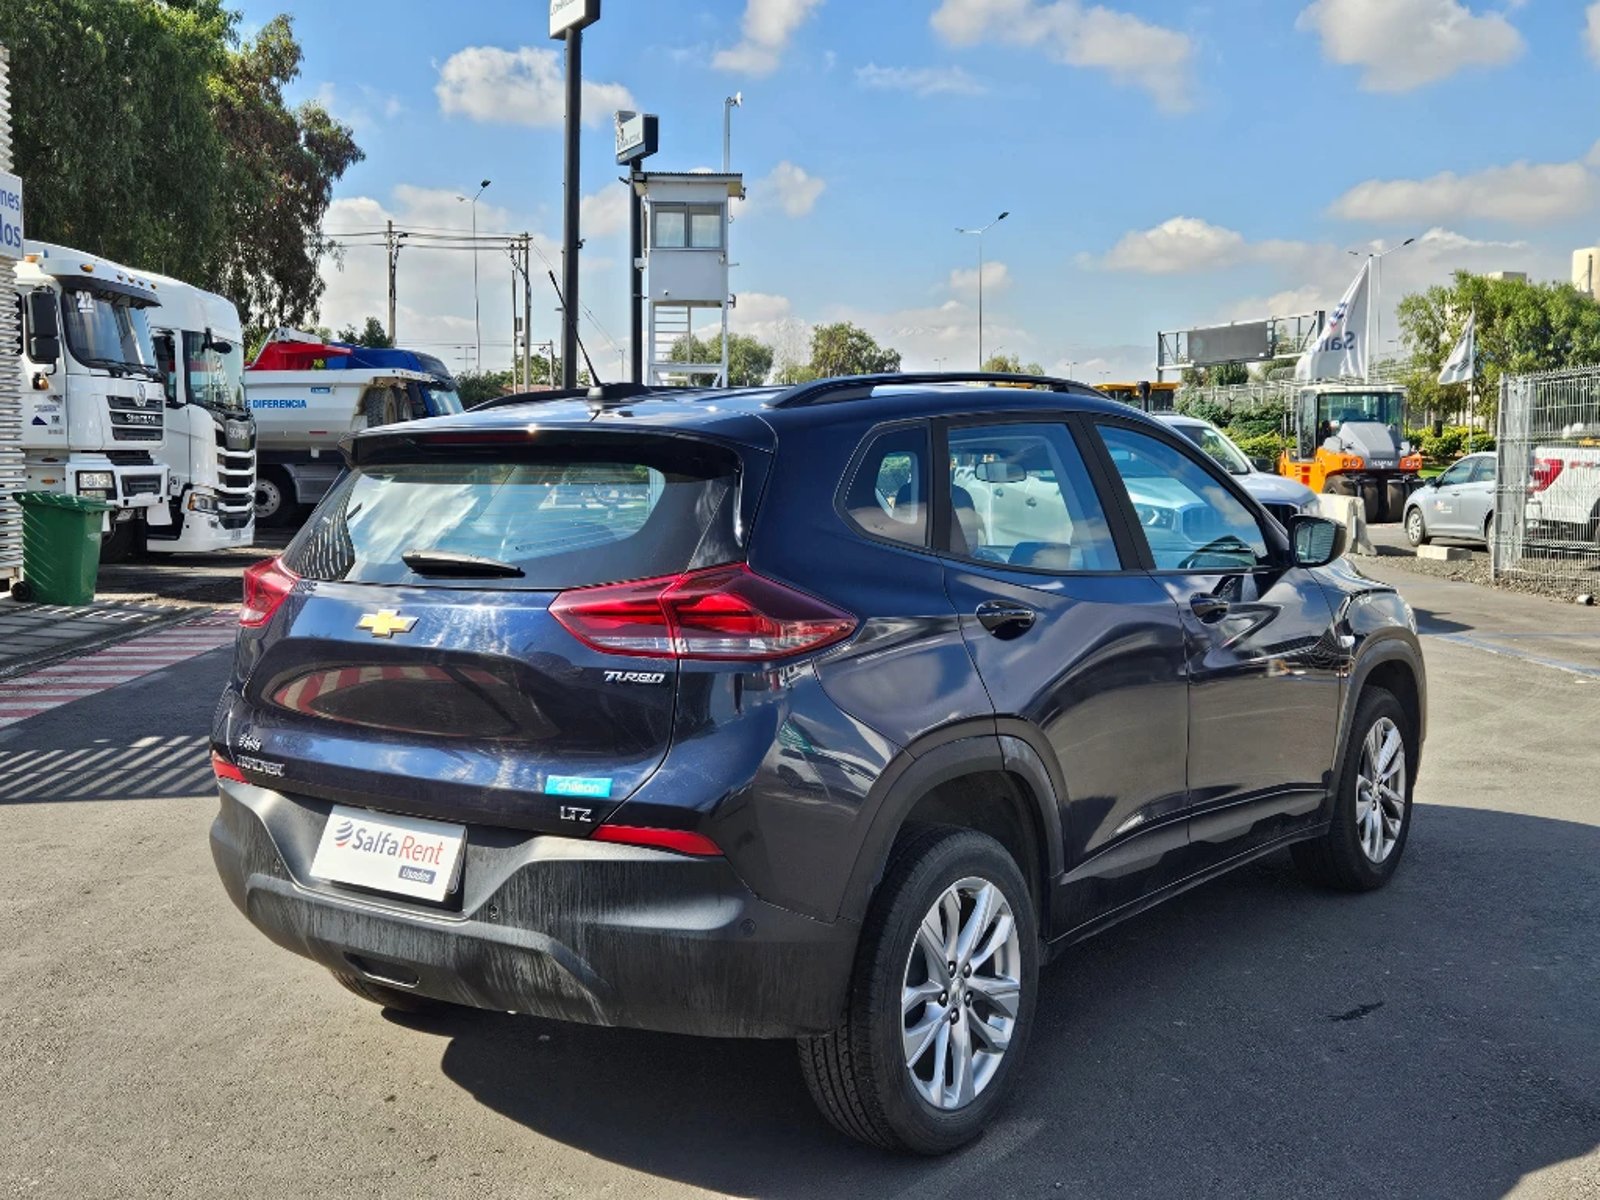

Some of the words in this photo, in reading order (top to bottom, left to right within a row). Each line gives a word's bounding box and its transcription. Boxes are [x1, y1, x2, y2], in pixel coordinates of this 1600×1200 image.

[253, 400, 307, 408] DIFERENCIA
[604, 670, 665, 684] TURBO
[560, 805, 592, 822] LTZ
[402, 867, 432, 882] Usados
